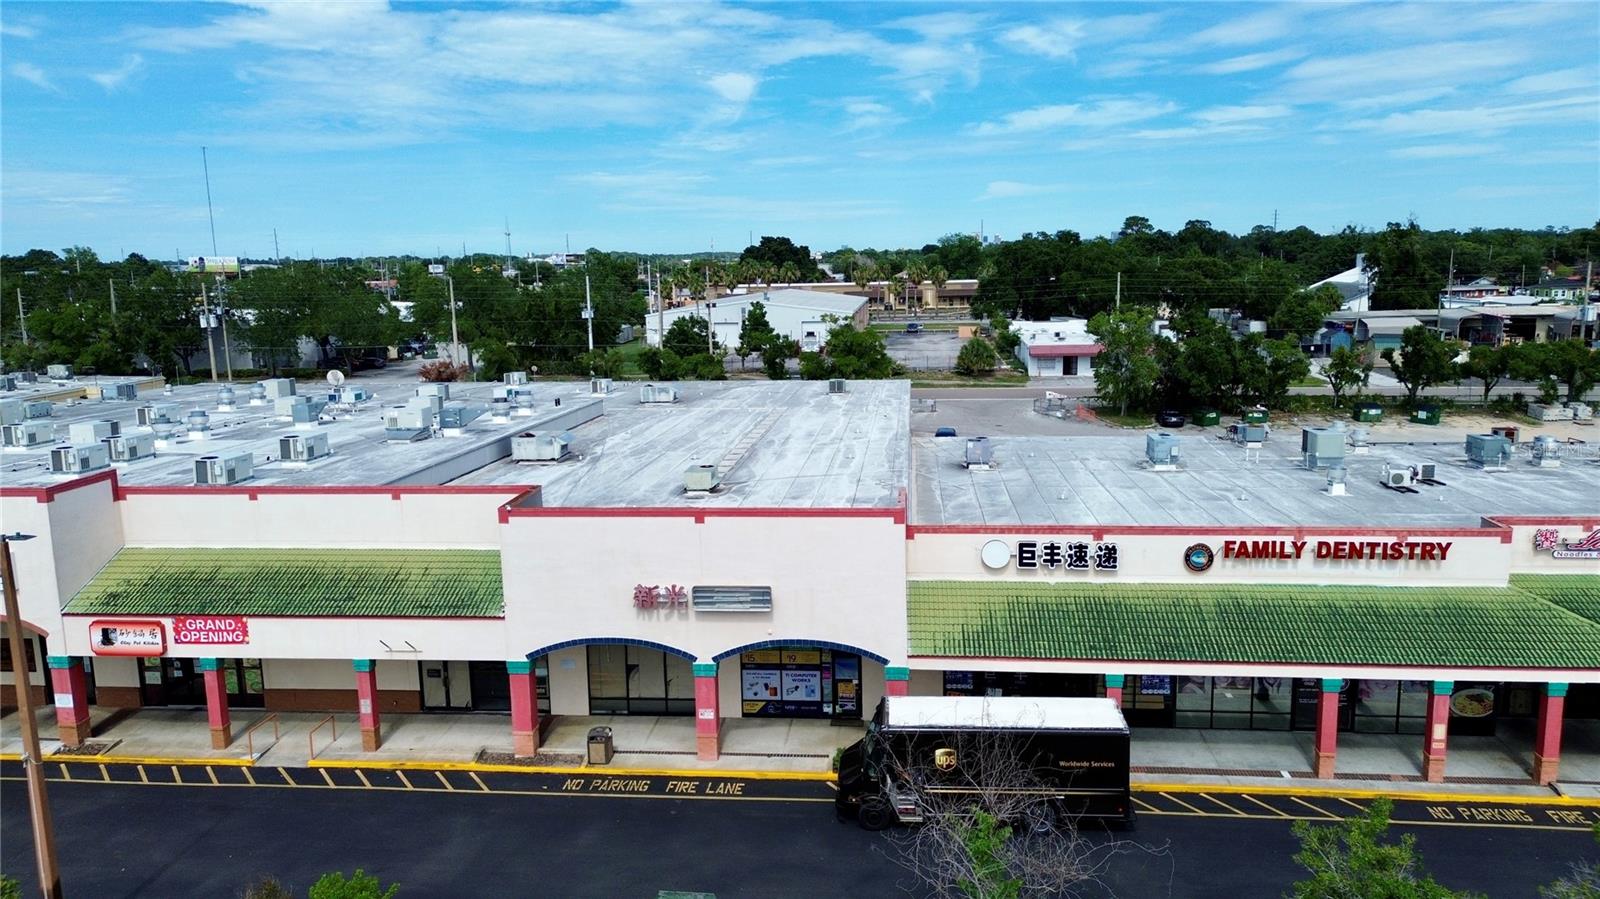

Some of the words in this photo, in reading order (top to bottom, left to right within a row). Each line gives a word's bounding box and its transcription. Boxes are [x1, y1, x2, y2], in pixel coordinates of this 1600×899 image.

[1016, 541, 1120, 571] 巨丰速递
[1224, 540, 1307, 559] FAMILY
[1316, 541, 1453, 561] DENTISTRY
[633, 584, 689, 609] 新光
[186, 619, 236, 630] GRAND
[180, 631, 244, 642] OPENING
[937, 755, 956, 768] ups
[563, 779, 584, 792] NO
[589, 779, 650, 793] PARKING
[665, 781, 699, 794] FIRE
[705, 782, 745, 795] LANE
[1426, 806, 1455, 820] NO
[1456, 807, 1534, 823] PARKING
[1545, 809, 1594, 825] FIRE
